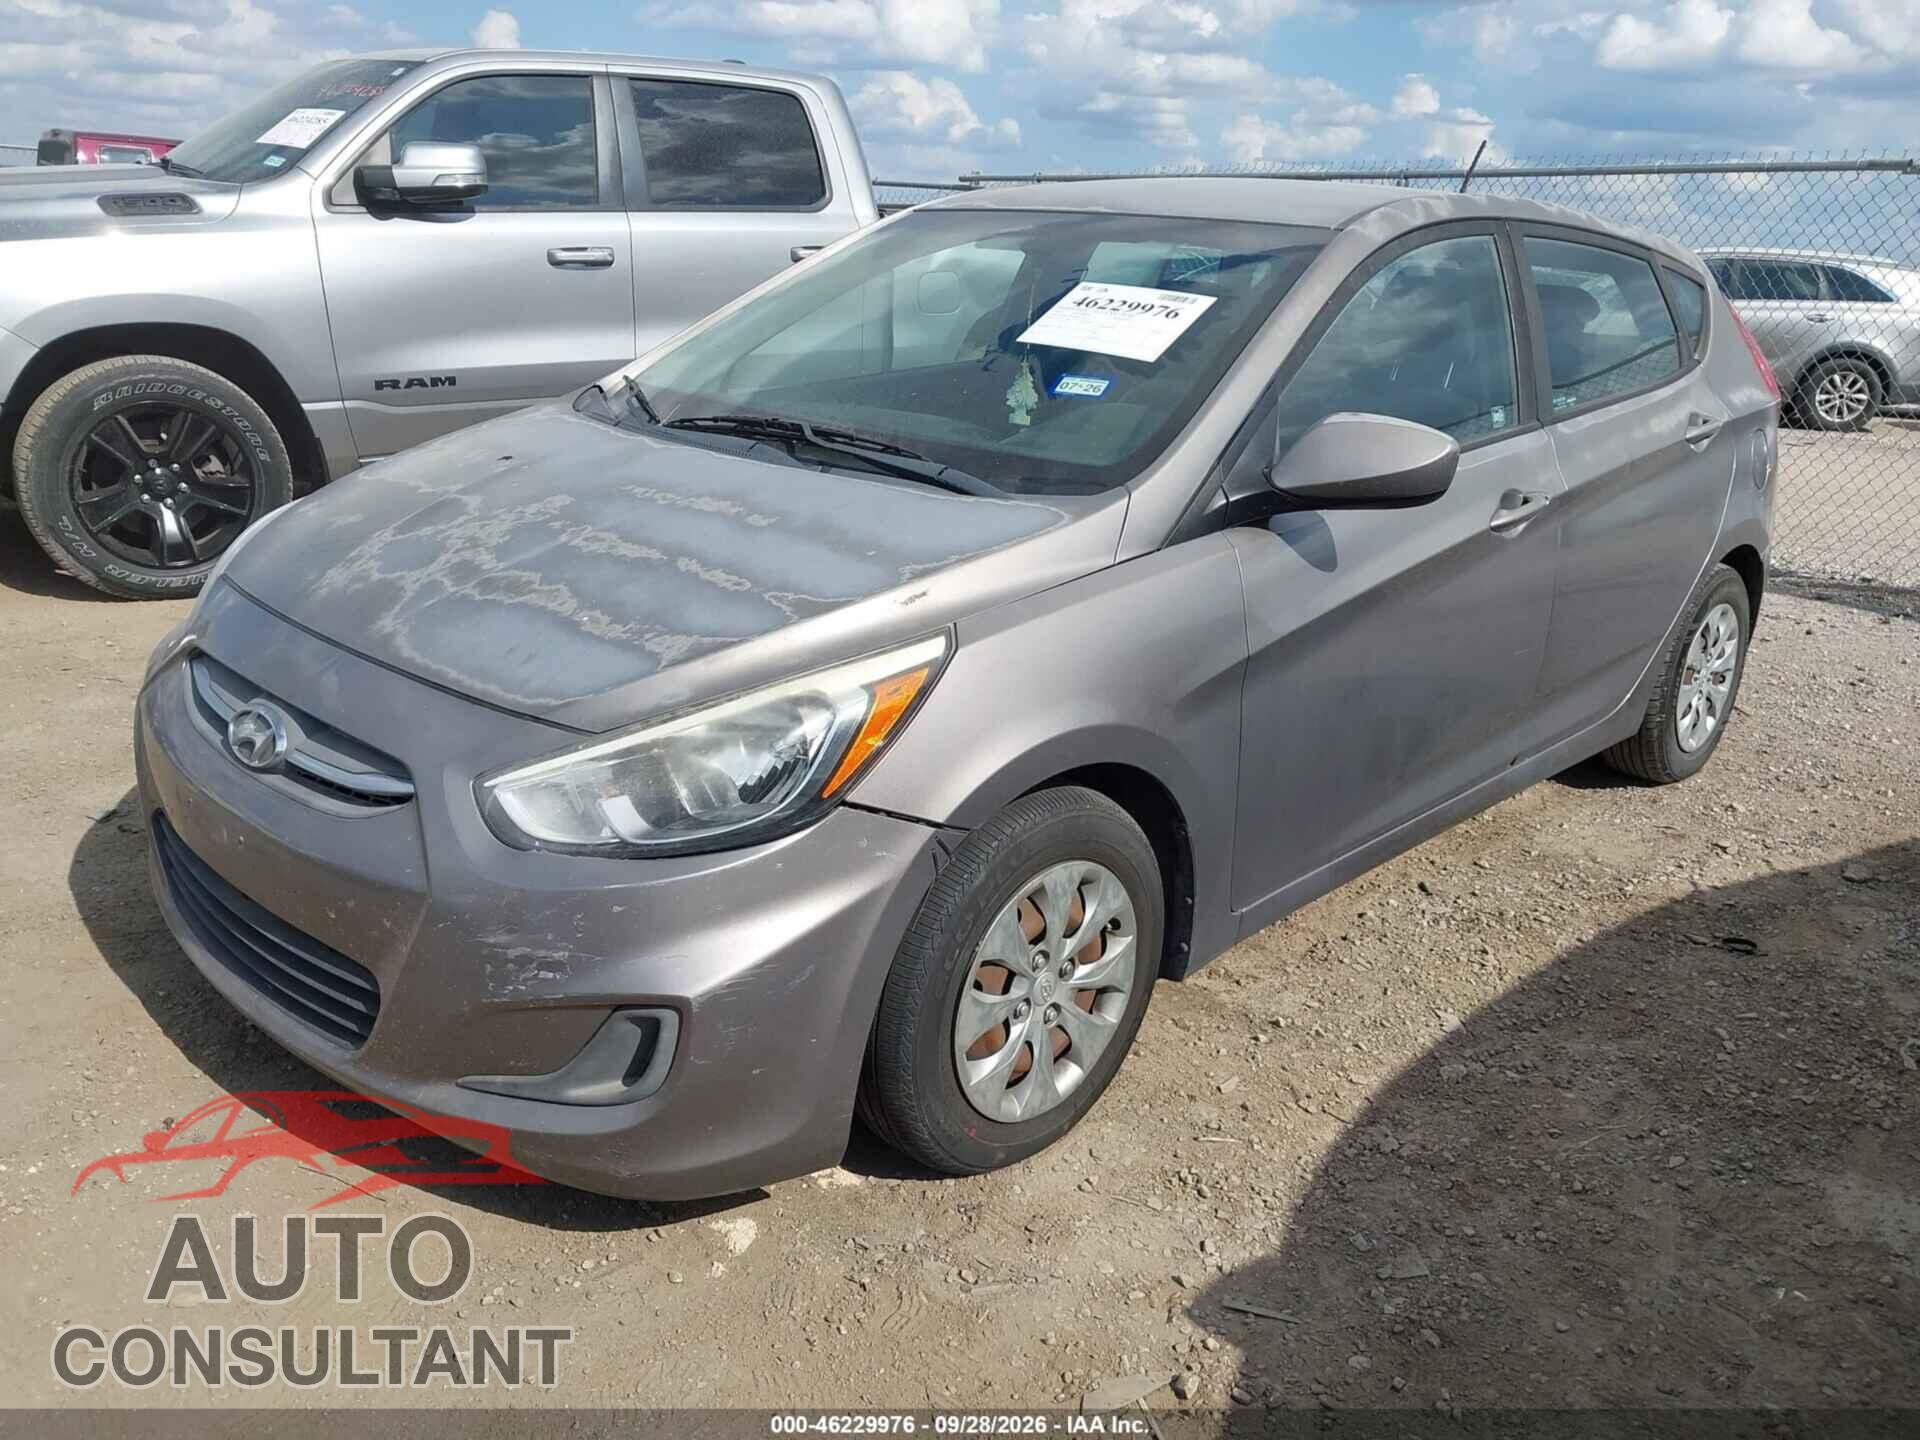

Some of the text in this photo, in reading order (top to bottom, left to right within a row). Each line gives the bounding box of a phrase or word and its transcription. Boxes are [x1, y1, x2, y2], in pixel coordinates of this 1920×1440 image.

[1072, 297, 1181, 320] 46229976
[374, 375, 457, 391] RAM
[93, 382, 271, 463] BRIDGESTONE
[104, 563, 208, 588] UELER
